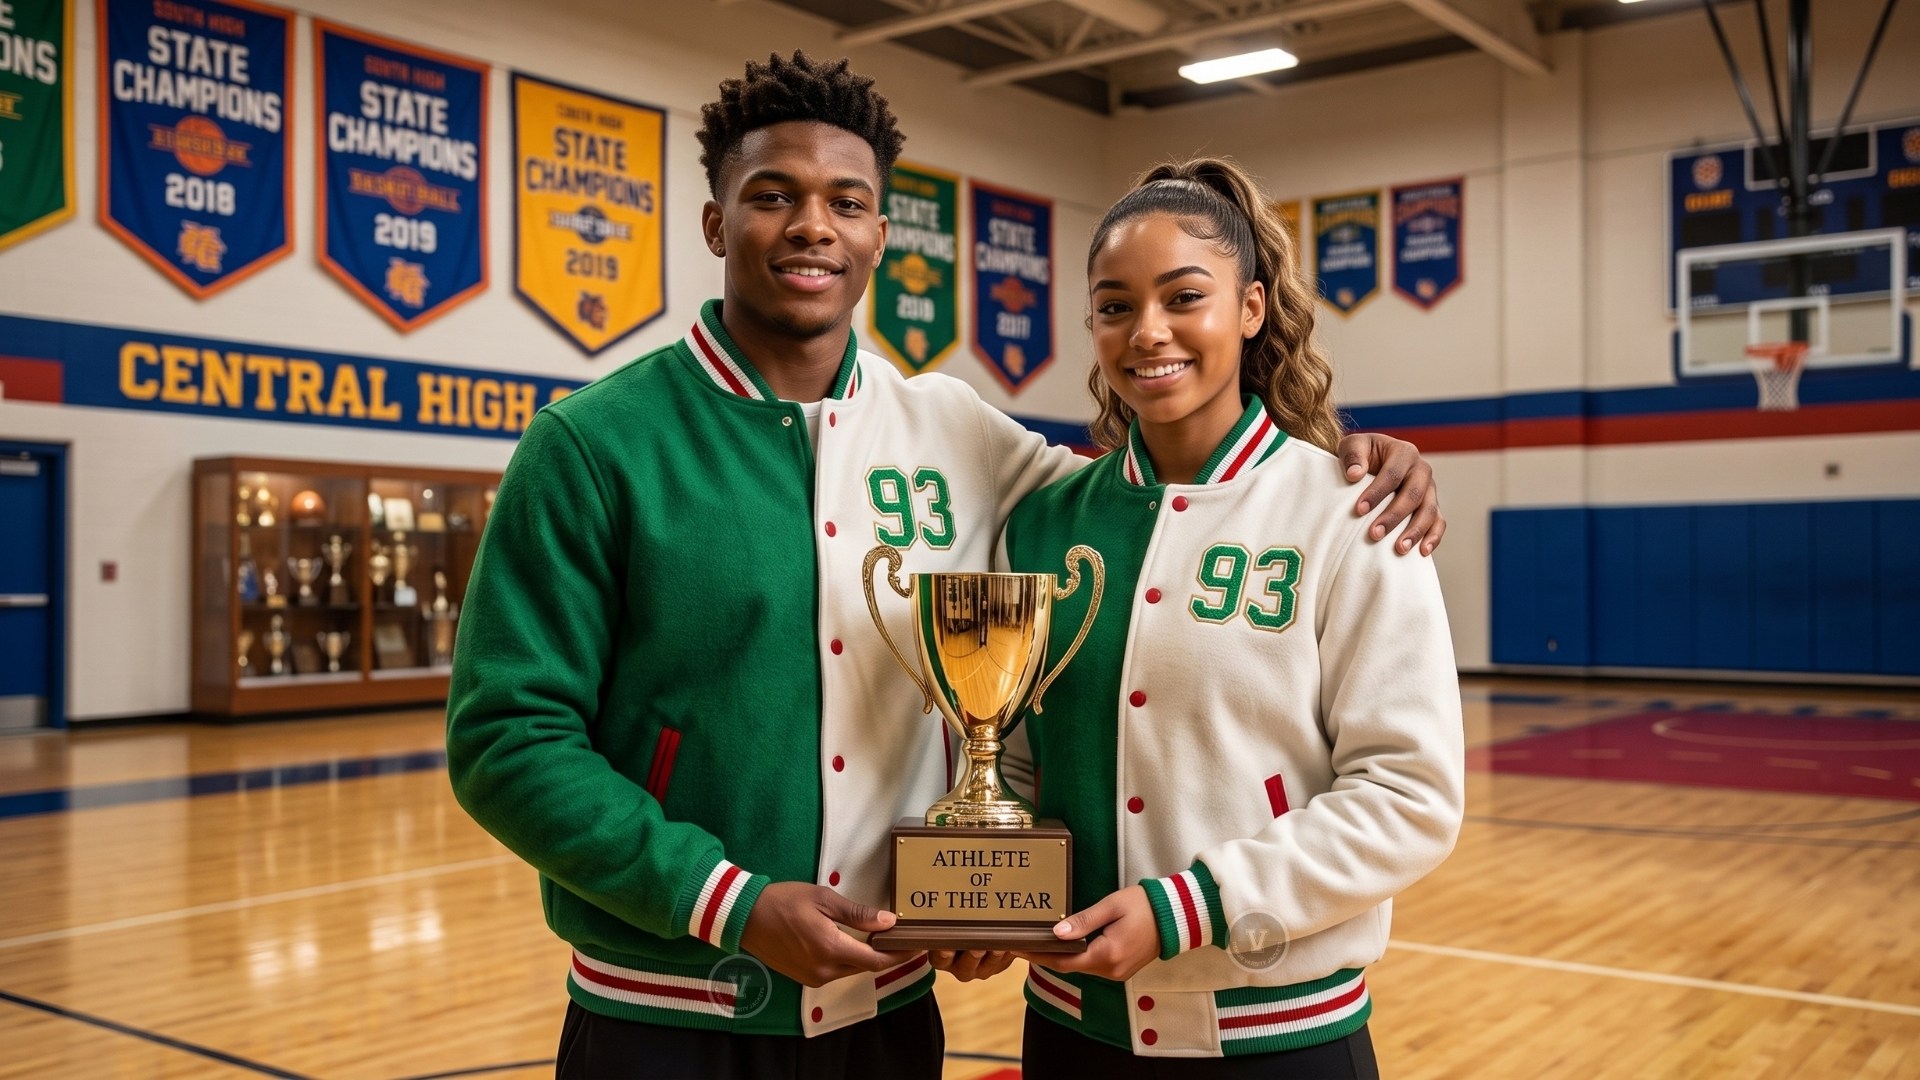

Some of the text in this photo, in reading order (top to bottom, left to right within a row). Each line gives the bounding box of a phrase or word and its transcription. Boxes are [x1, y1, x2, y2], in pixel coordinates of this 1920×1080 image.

[148, 25, 250, 84] STATE
[113, 58, 282, 133] CHAMPIONS
[360, 80, 449, 135] STATE
[328, 111, 477, 181] CHAMPIONS
[554, 126, 628, 172] STATE
[165, 172, 236, 216] 2018
[525, 156, 655, 215] CHAMPIONS
[374, 213, 437, 254] 2019
[888, 192, 940, 231] STATE
[886, 223, 955, 263] AMPIONS
[988, 217, 1037, 254] STATE
[565, 248, 619, 282] 2019
[975, 240, 1050, 285] CHAMPIONS
[118, 341, 537, 432] CENTRAL HIGH
[864, 465, 957, 551] 93
[1188, 541, 1306, 633] 93
[932, 850, 1031, 868] ATHLETE
[970, 873, 993, 886] OF
[910, 891, 1053, 910] OF THE YEAR
